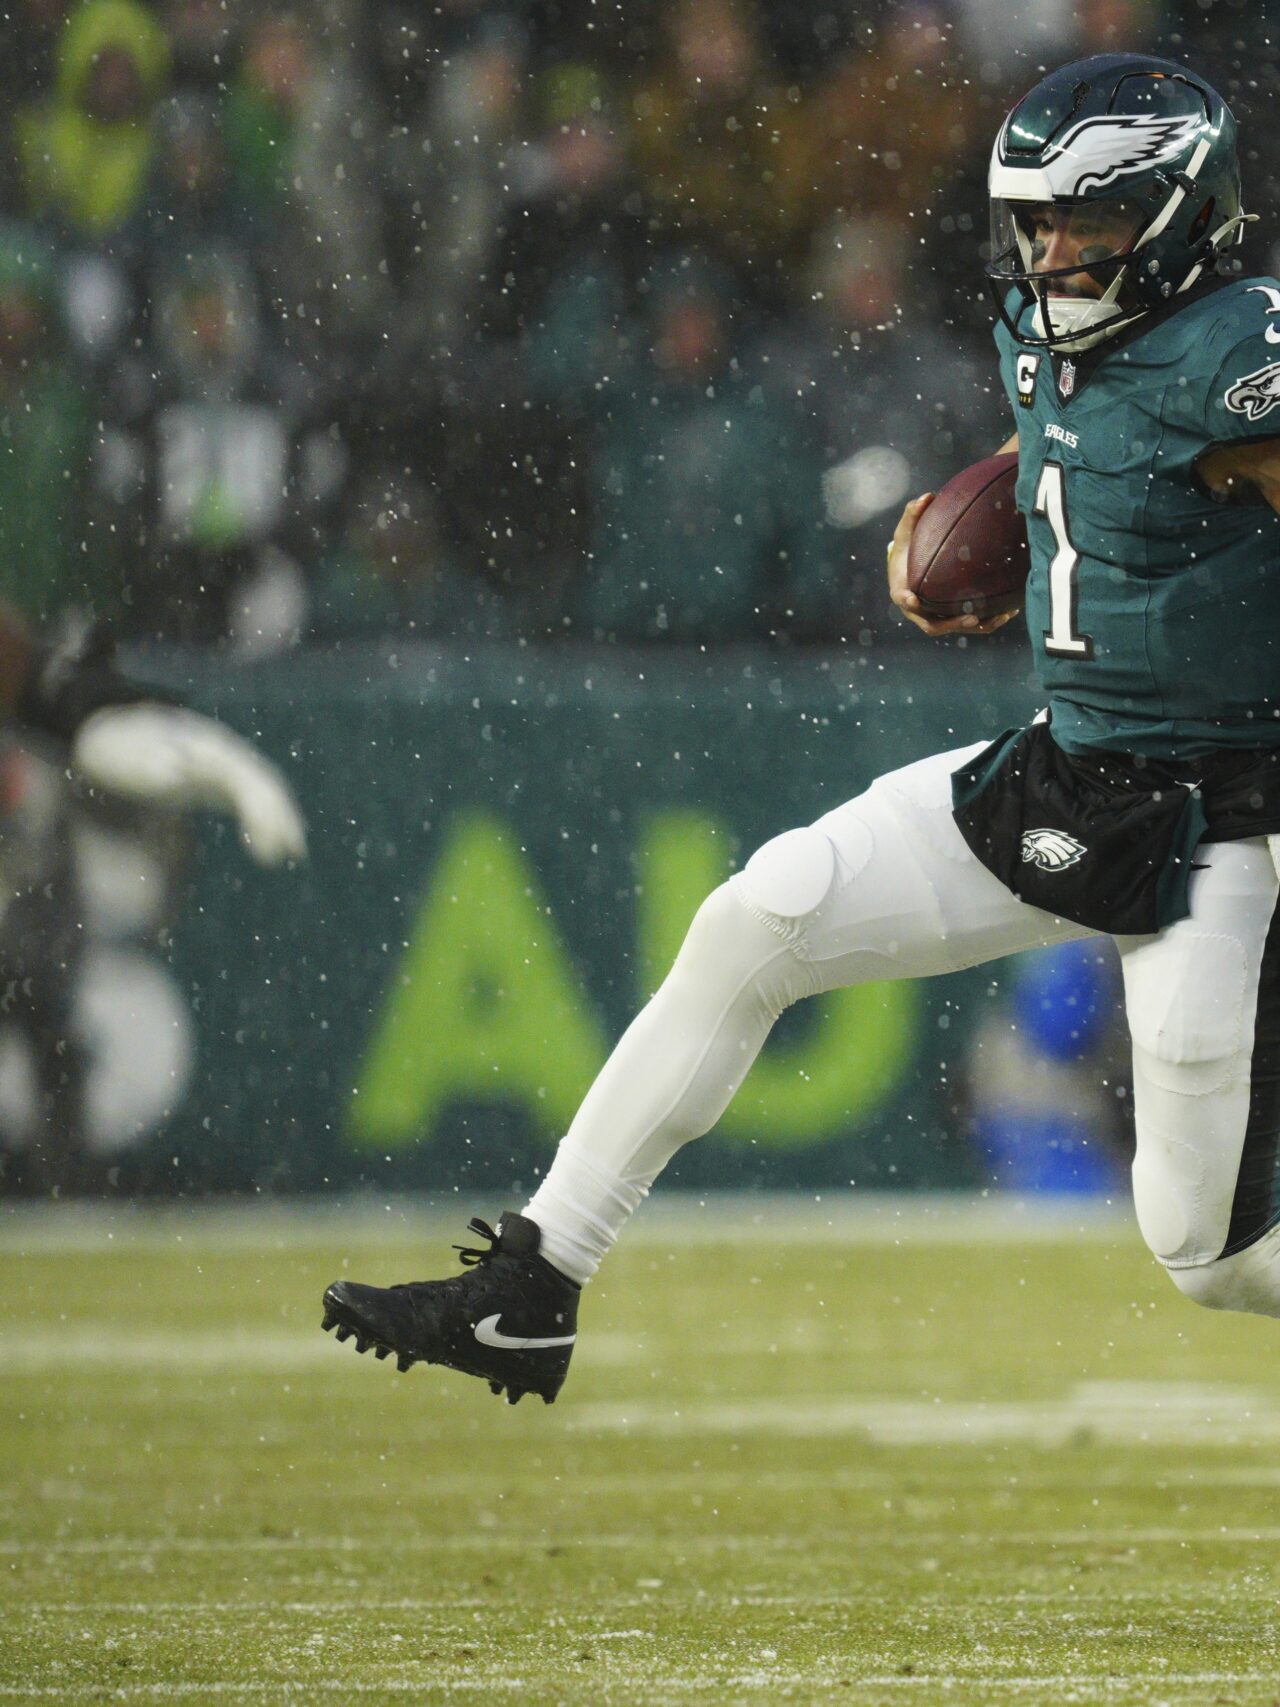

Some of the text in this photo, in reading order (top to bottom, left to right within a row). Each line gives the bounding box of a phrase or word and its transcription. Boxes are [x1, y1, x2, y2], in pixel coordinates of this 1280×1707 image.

[1016, 353, 1039, 395] C
[1044, 423, 1080, 449] EAGLES
[1034, 462, 1092, 657] 1
